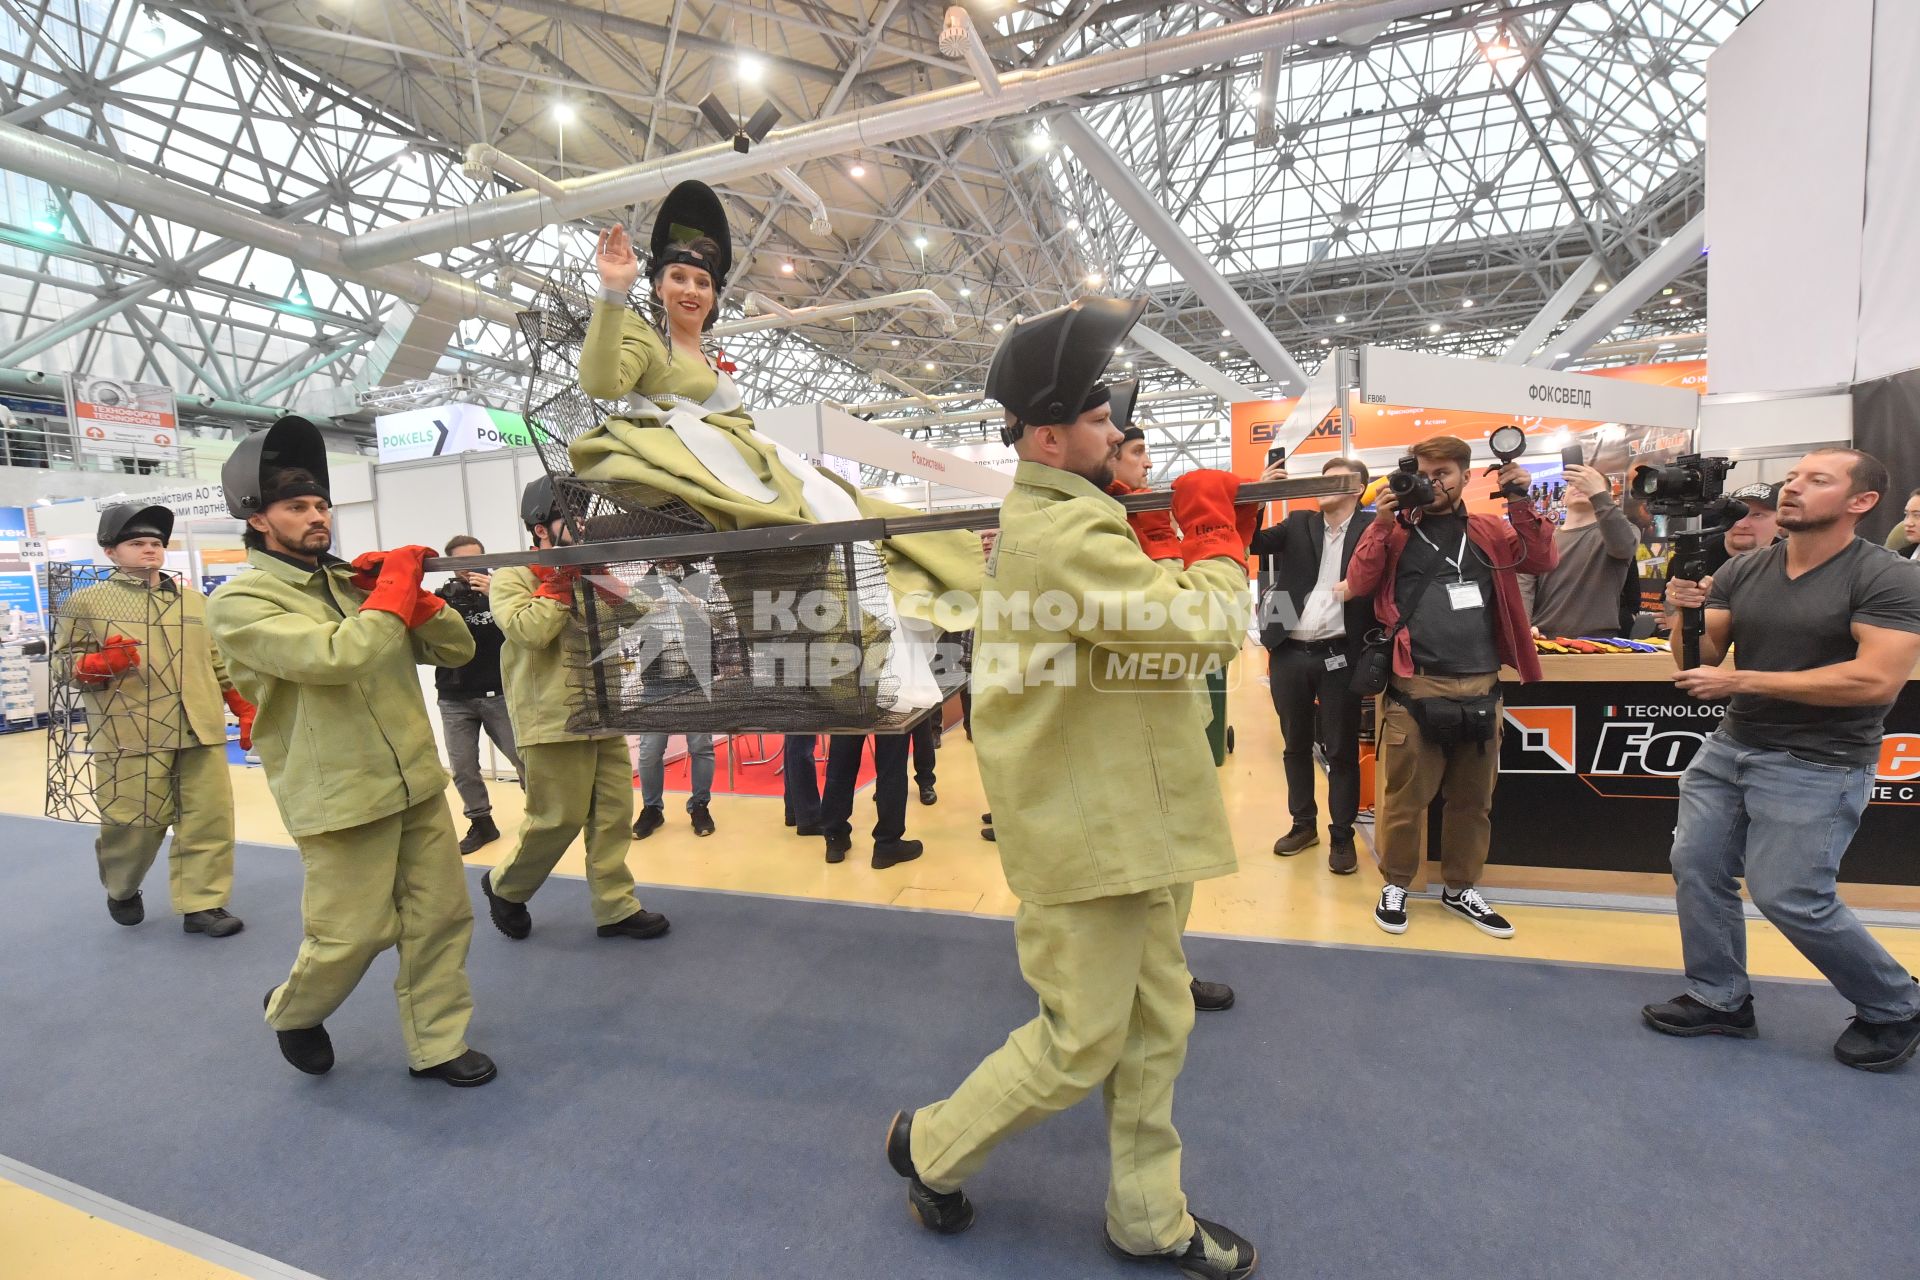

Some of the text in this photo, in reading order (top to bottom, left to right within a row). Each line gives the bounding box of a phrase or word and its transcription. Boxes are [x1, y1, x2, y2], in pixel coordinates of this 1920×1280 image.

[1367, 394, 1387, 403] FB060
[1529, 384, 1592, 408] ФОКСВЕЛД
[195, 487, 210, 500] АО
